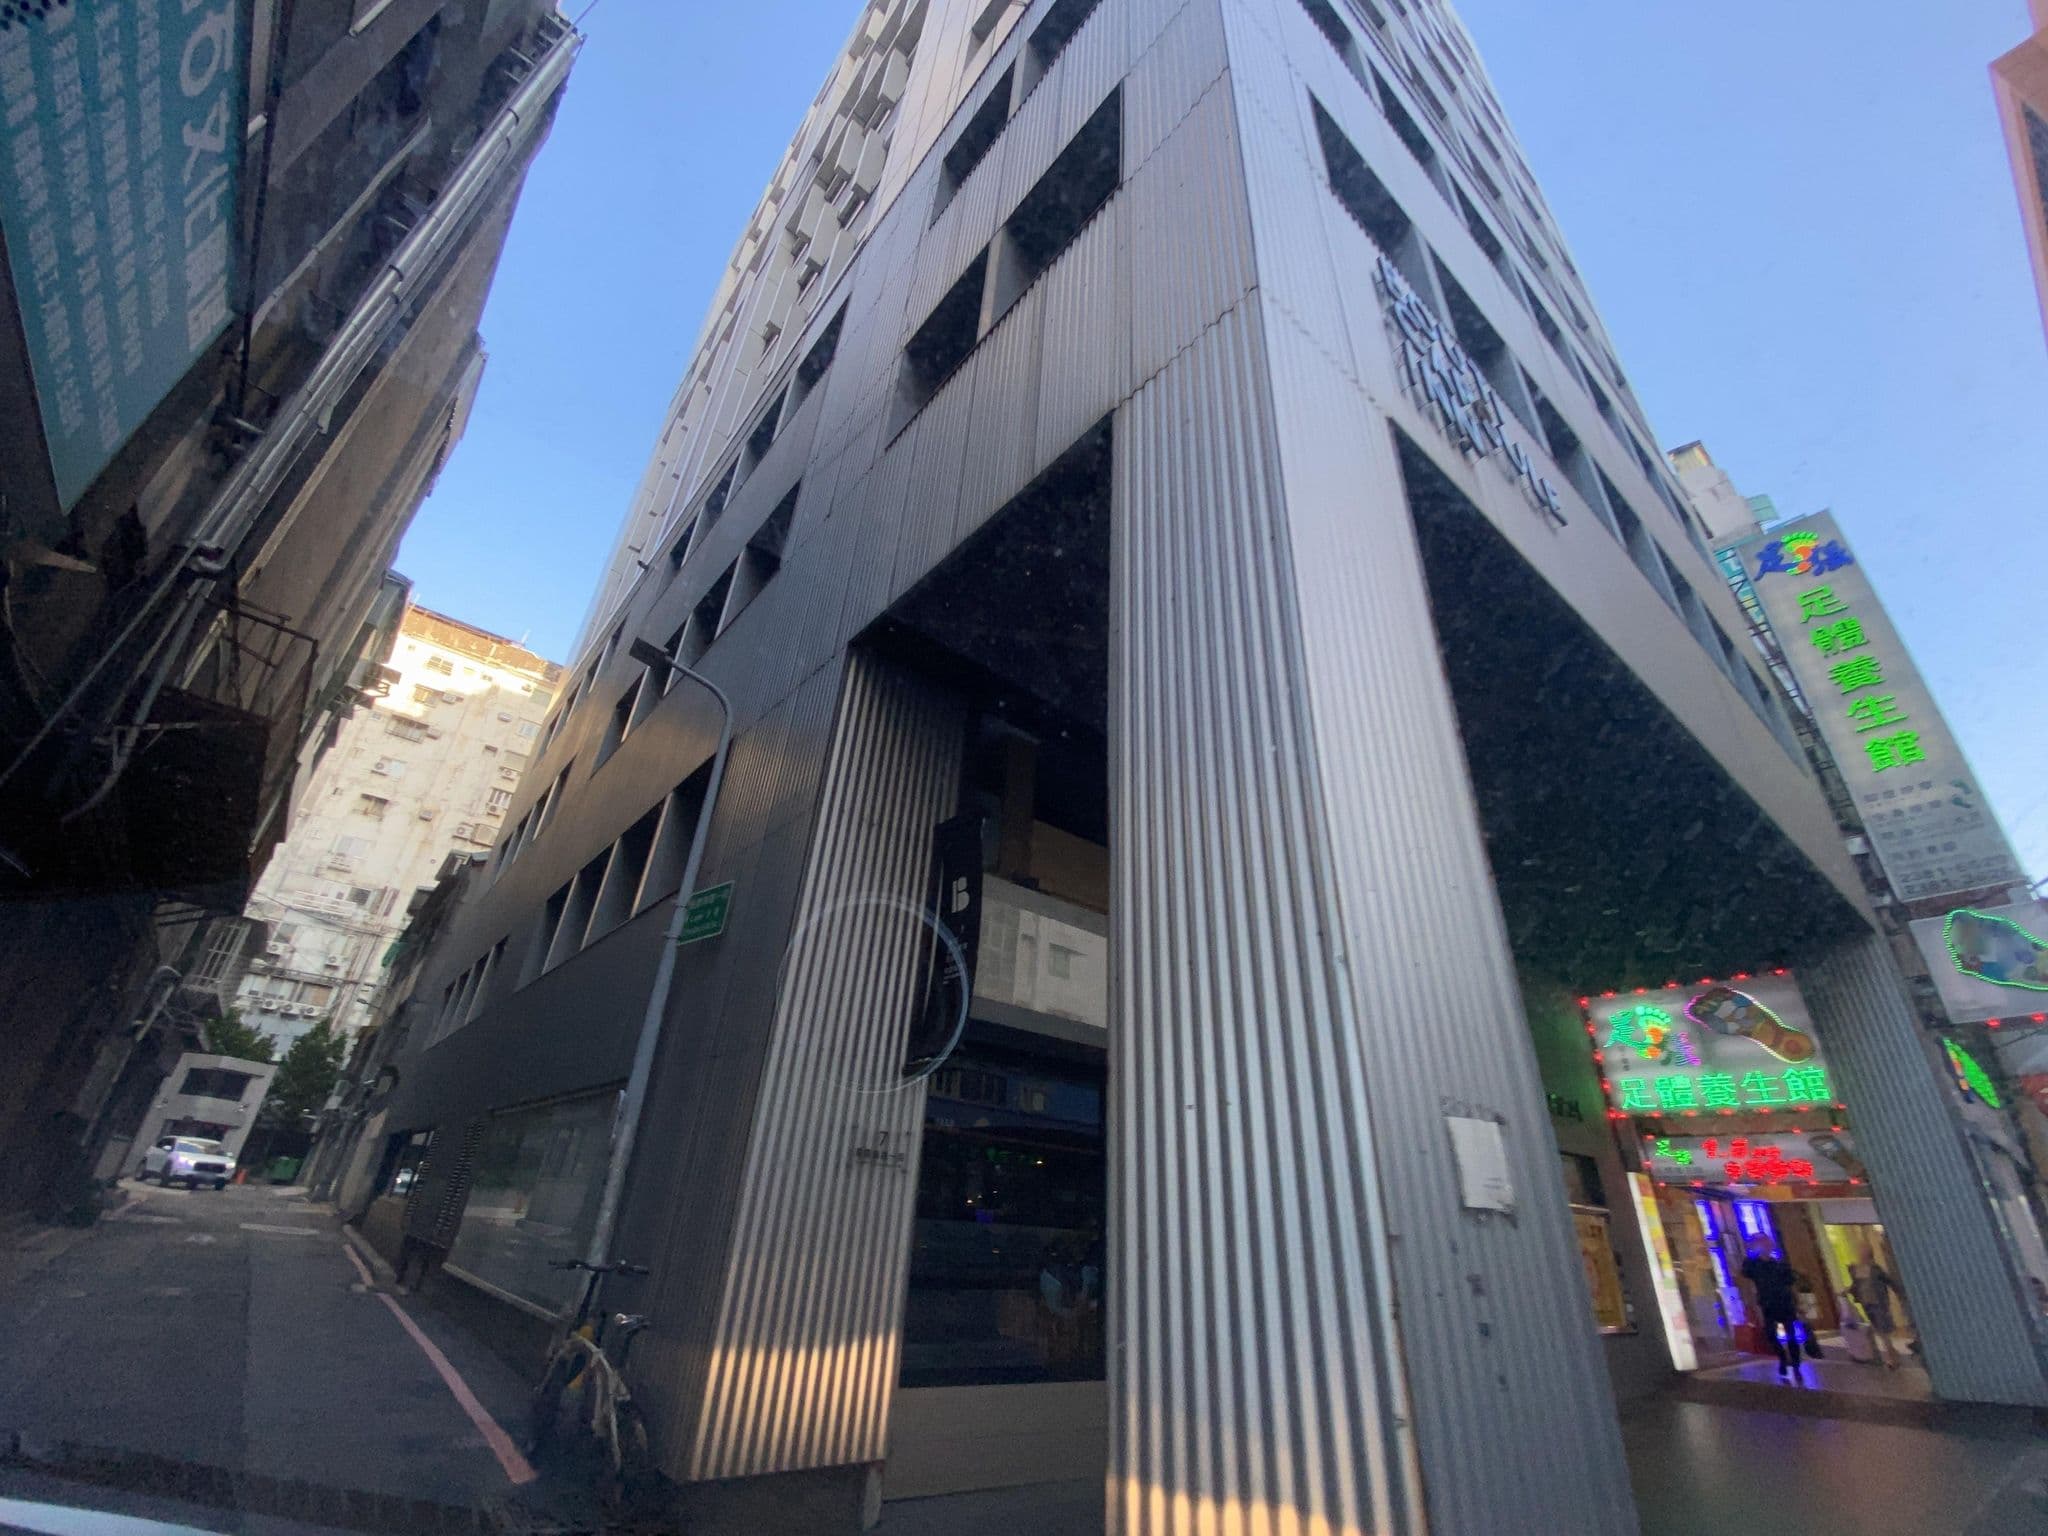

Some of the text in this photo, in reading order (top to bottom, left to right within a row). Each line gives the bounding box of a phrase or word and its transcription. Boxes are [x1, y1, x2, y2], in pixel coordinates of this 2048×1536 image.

[1797, 585, 1926, 774] 足體養生館
[1619, 1066, 1832, 1110] 足體養生館
